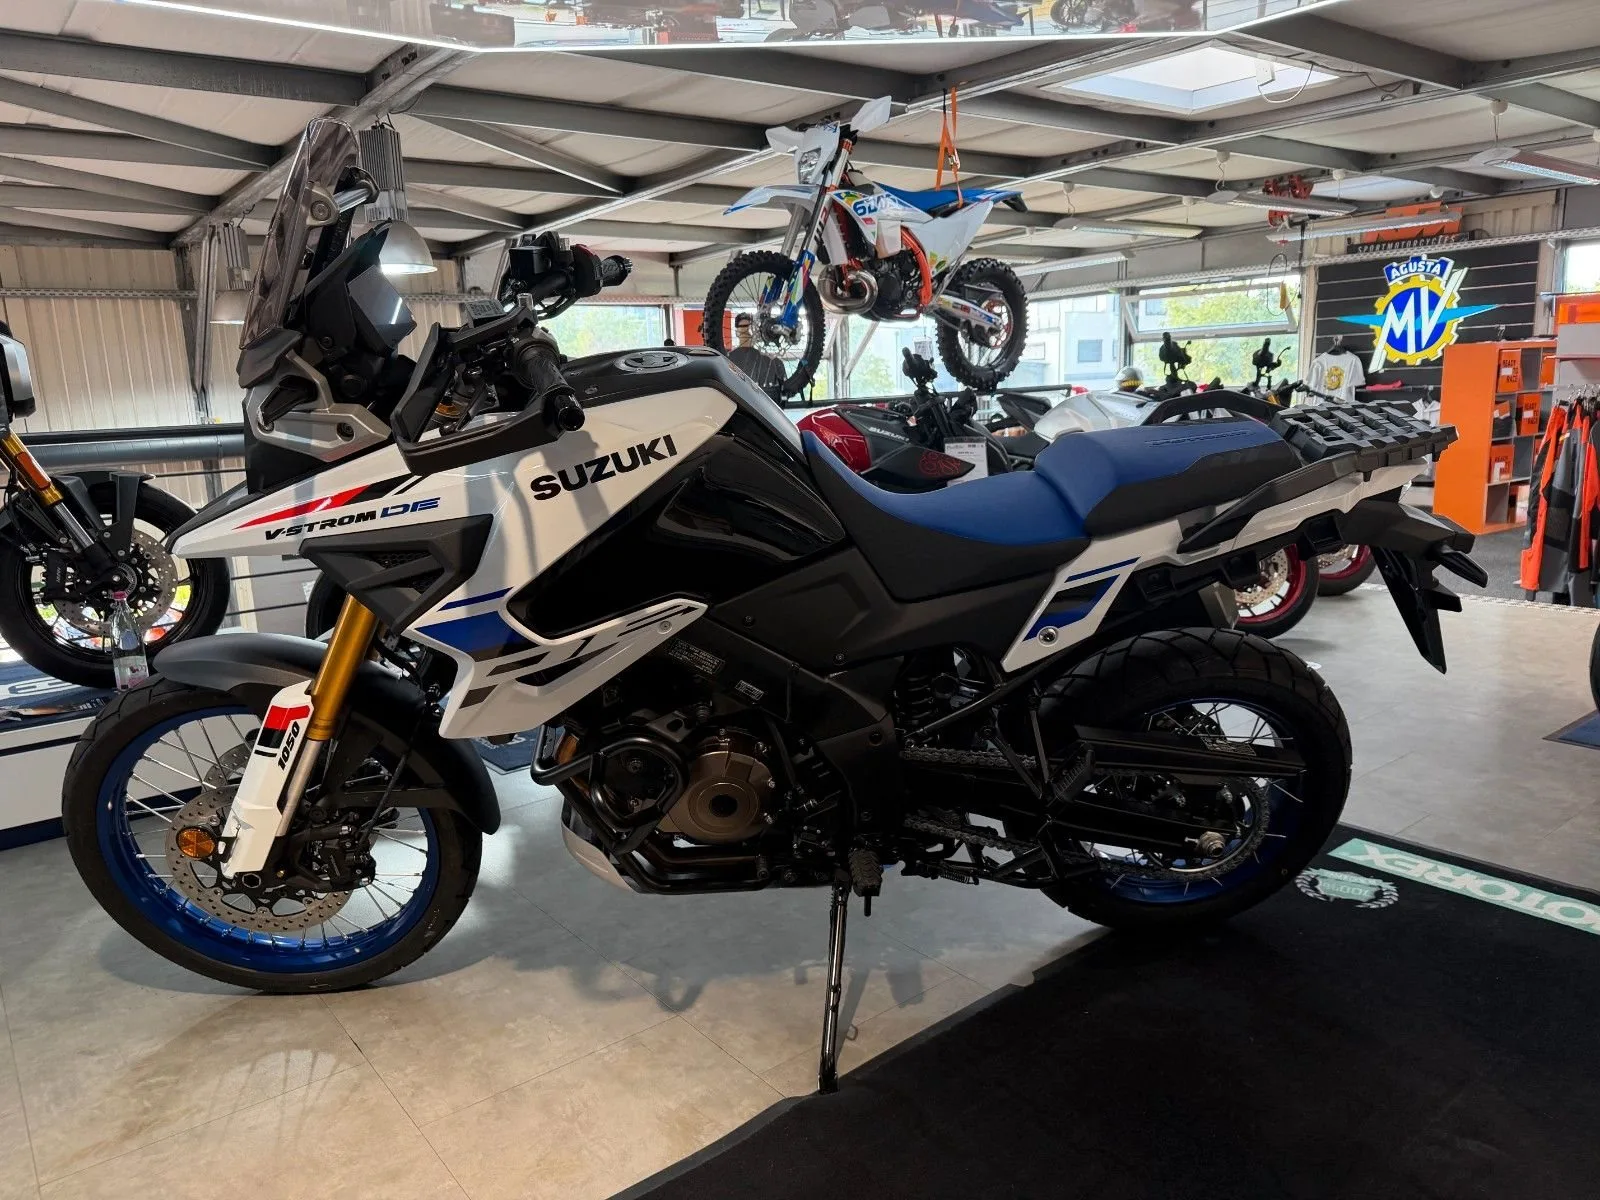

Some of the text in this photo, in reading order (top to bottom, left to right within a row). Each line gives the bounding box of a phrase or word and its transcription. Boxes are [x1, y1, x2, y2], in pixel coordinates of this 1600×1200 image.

[1390, 260, 1442, 280] AGUSTA
[868, 426, 910, 442] SUZUKI
[530, 434, 678, 501] SUZUKI
[265, 497, 441, 541] V-STROM DE
[277, 720, 300, 771] 1050
[1343, 843, 1600, 930] OTOREX
